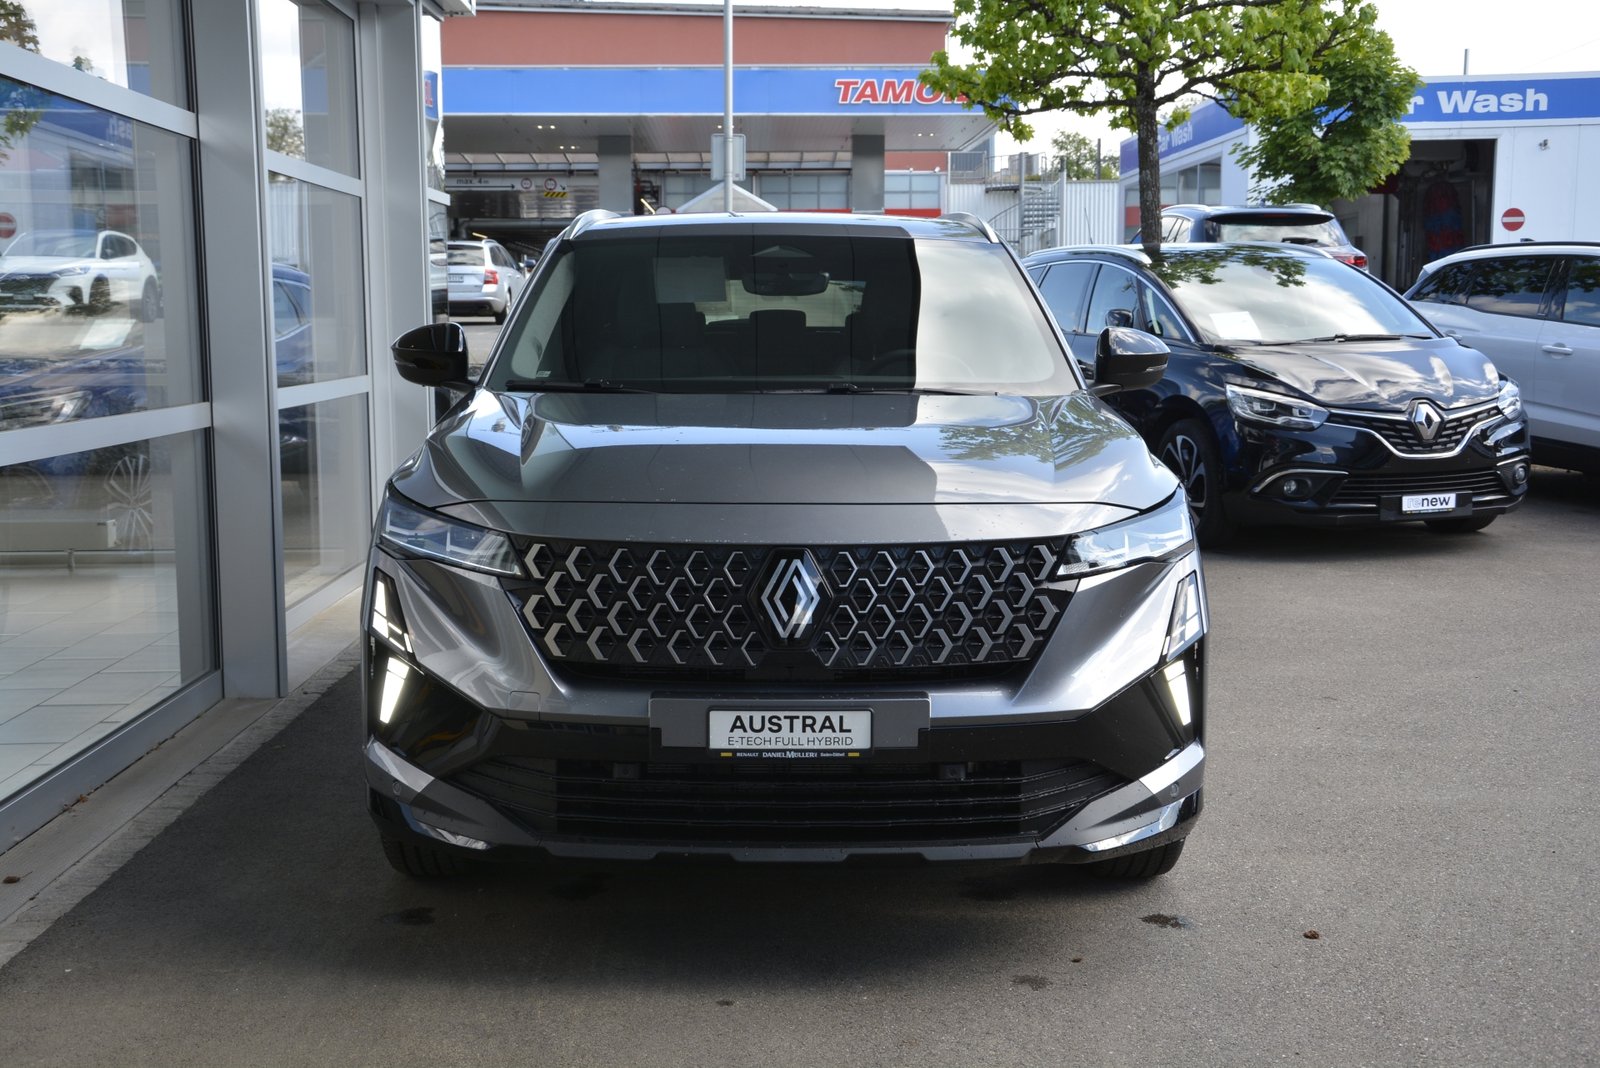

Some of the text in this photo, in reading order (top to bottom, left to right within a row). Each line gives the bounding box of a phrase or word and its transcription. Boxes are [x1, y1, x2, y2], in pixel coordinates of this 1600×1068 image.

[1436, 88, 1549, 114] Wash
[729, 715, 852, 733] AUSTRAL
[728, 736, 854, 746] E-TECH FULL HYBRID
